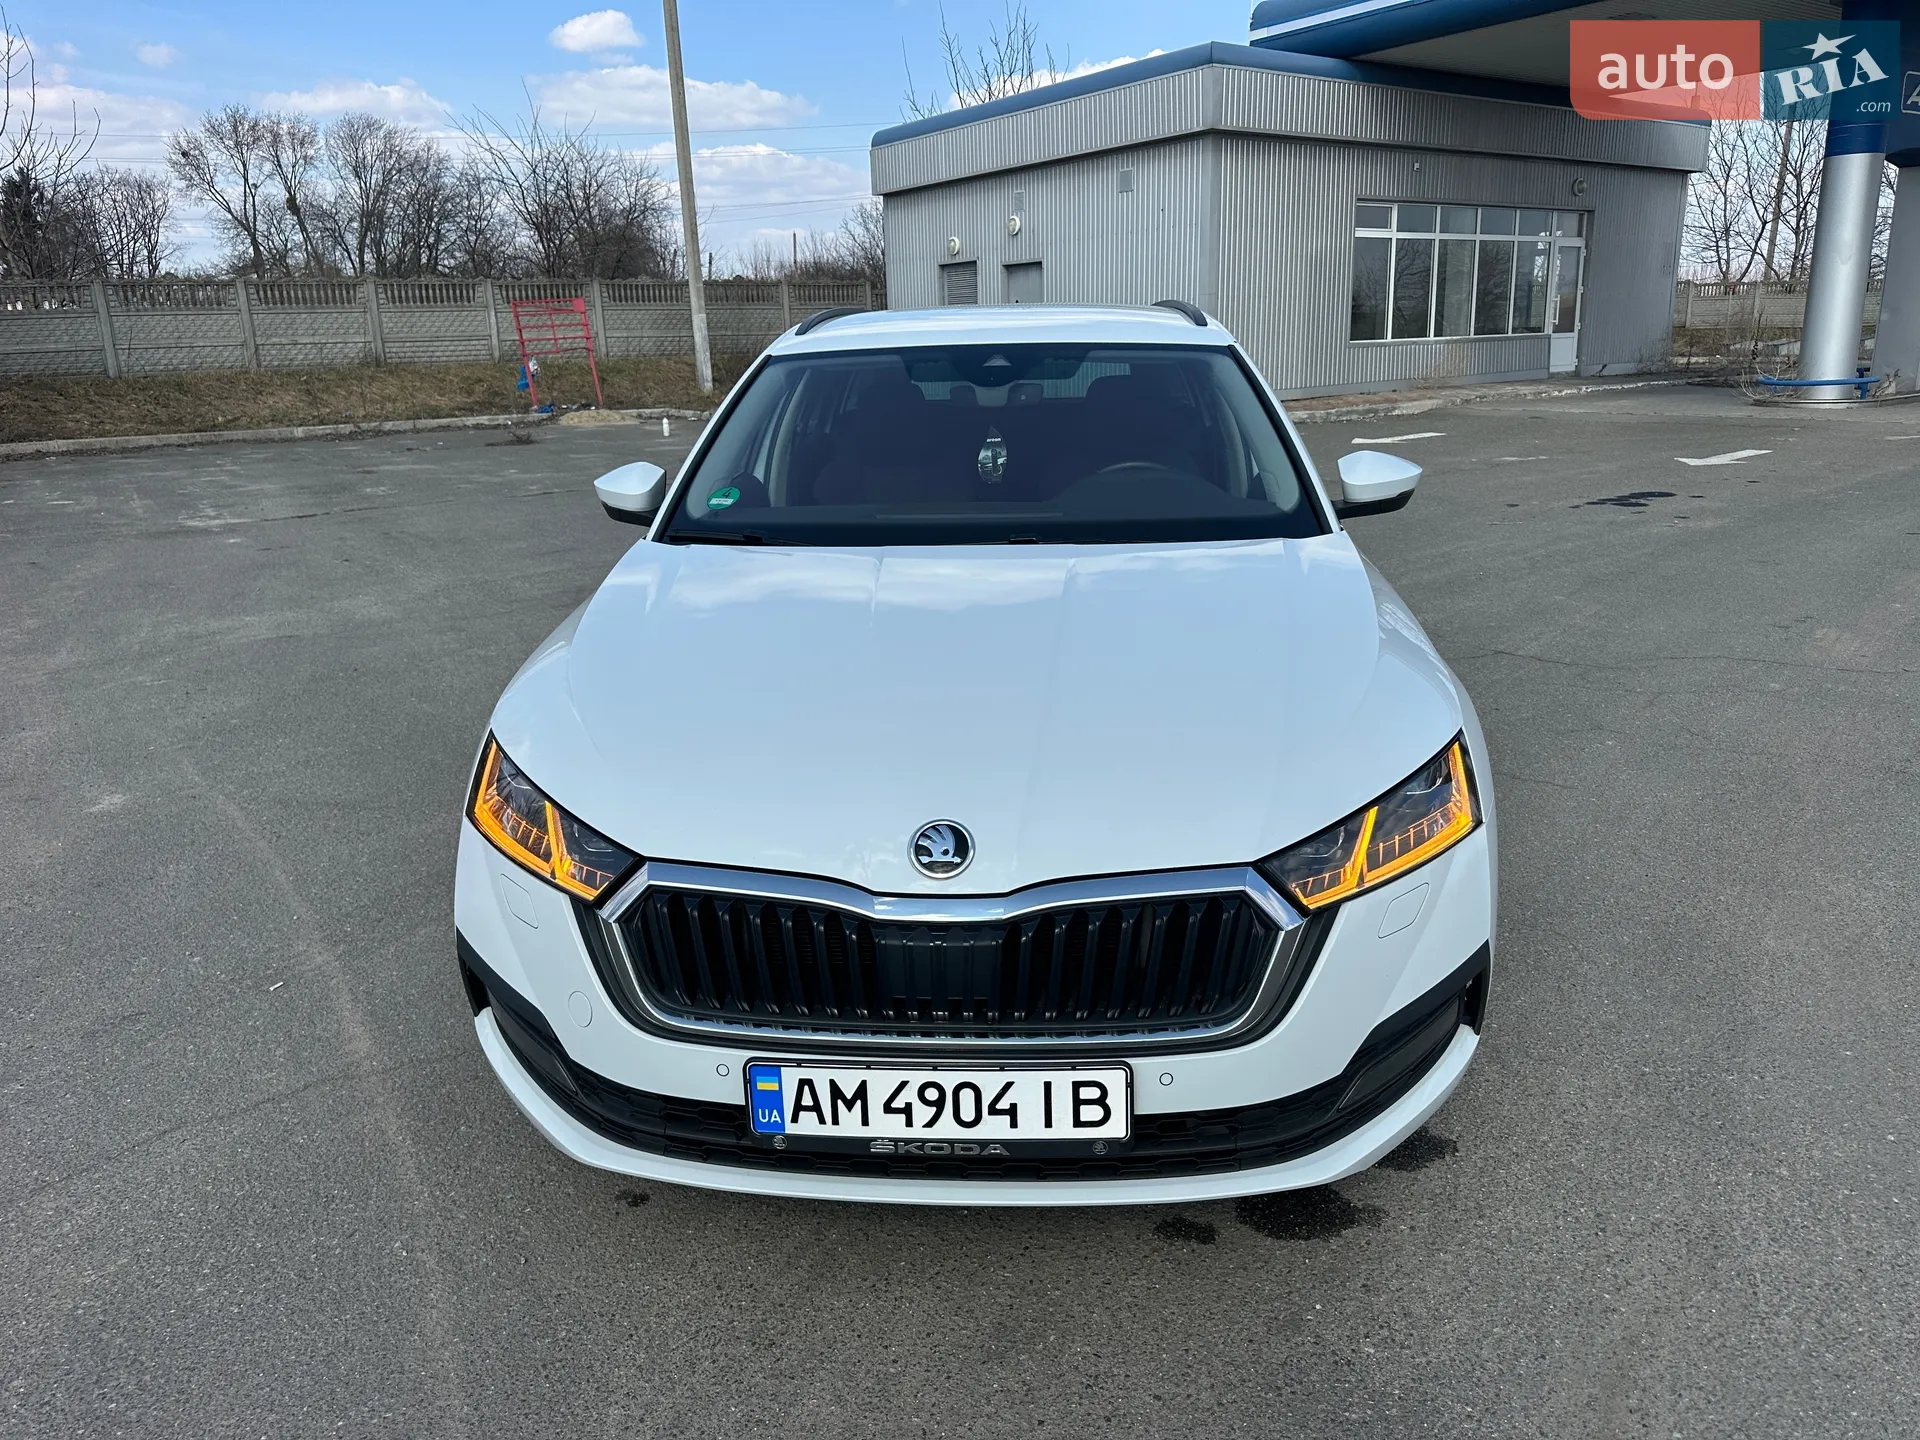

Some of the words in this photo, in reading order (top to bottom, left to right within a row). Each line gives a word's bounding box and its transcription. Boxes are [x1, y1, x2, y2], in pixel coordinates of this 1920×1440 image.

[721, 487, 733, 498] 4
[790, 1077, 870, 1127] AM
[882, 1080, 1019, 1129] 4904
[1043, 1080, 1112, 1129] IB
[758, 1108, 782, 1124] UA
[869, 1138, 1011, 1157] ŠKODA
